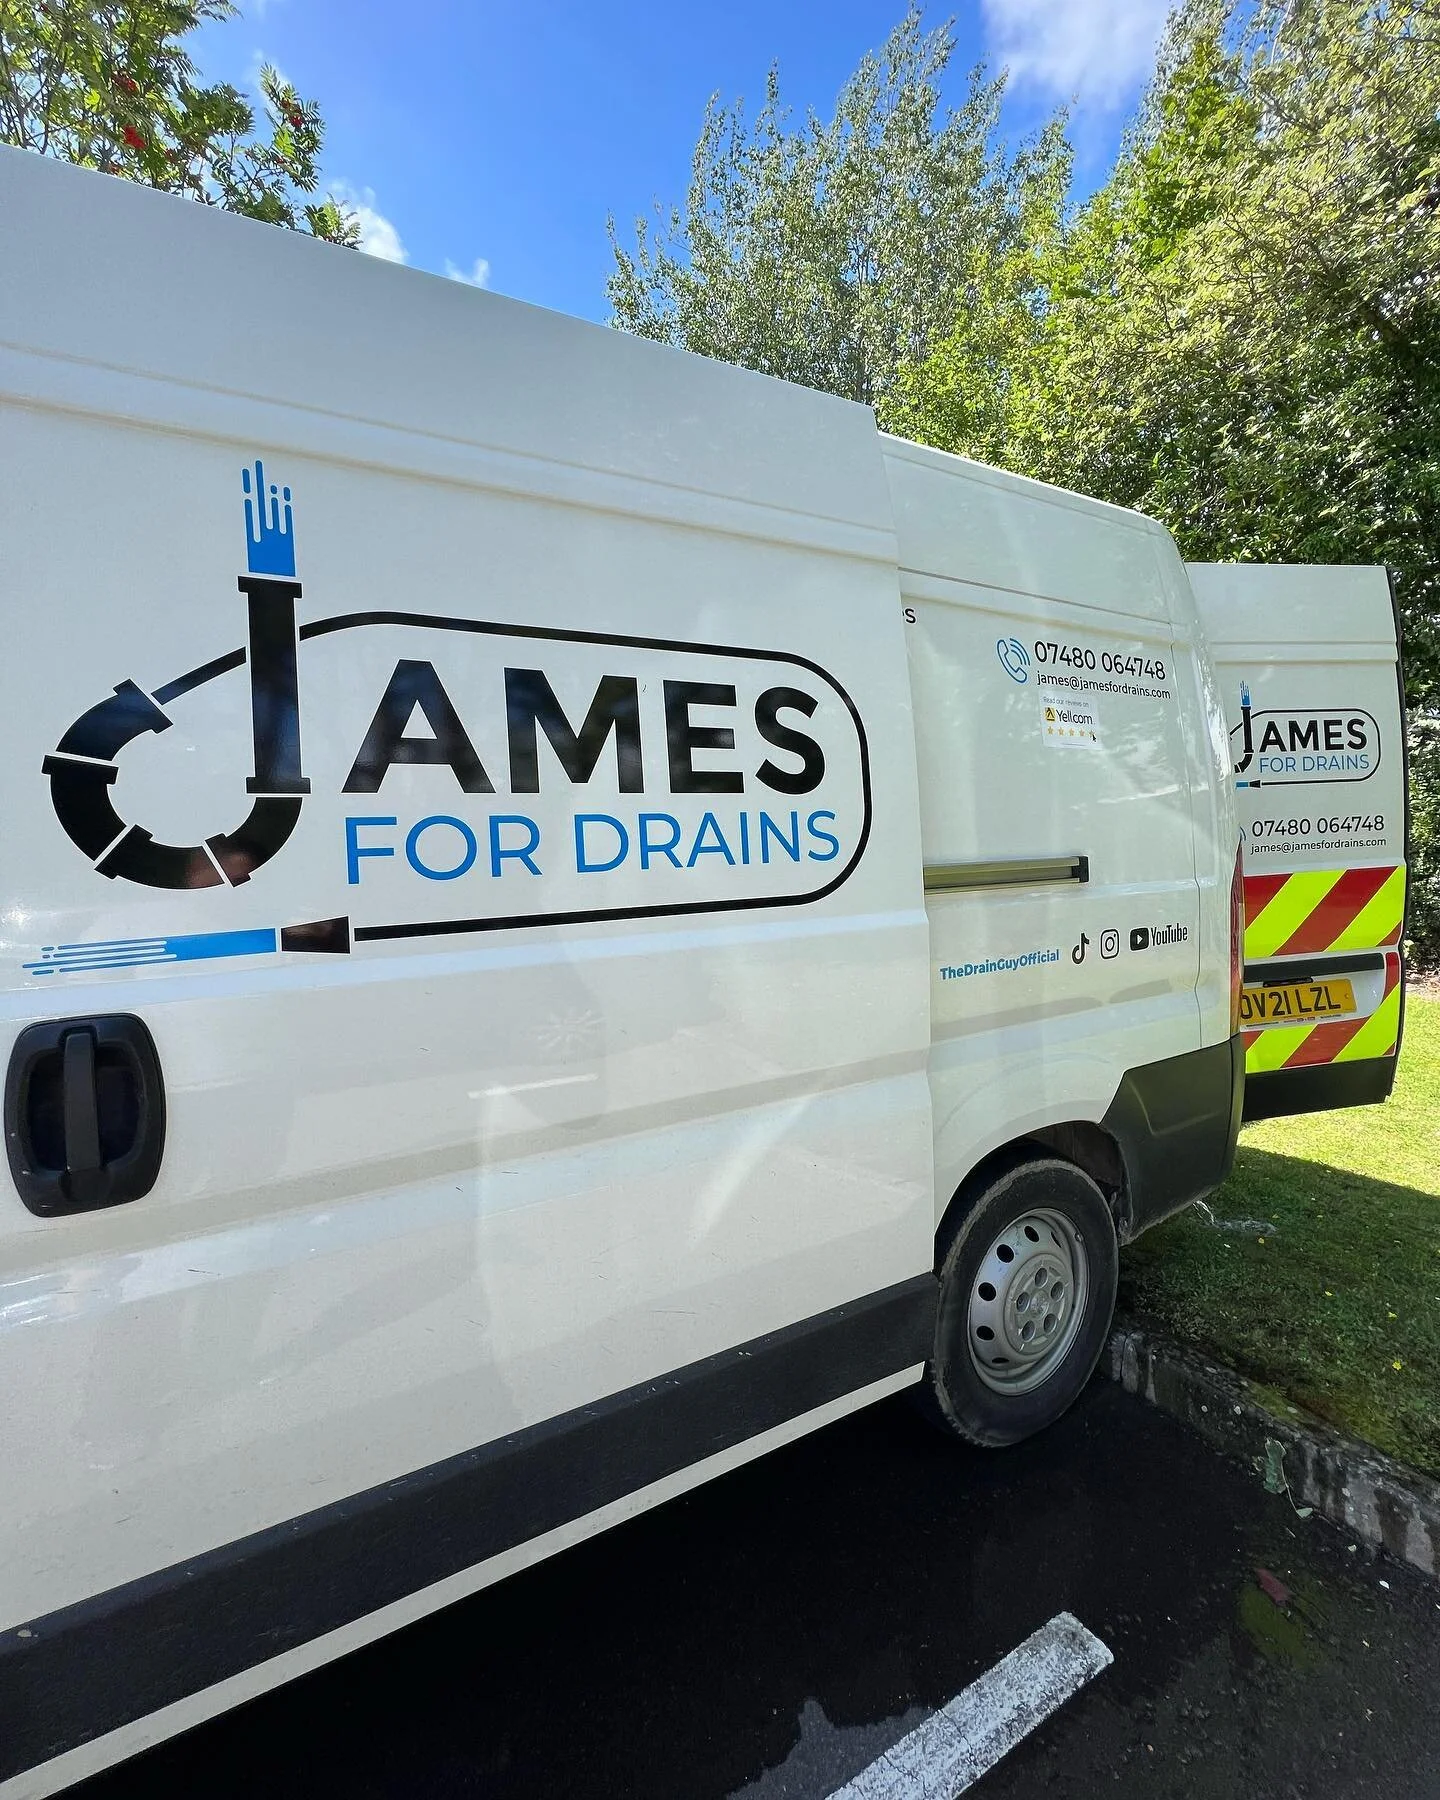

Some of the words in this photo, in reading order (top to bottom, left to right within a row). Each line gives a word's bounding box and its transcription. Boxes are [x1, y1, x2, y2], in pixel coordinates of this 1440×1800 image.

[1034, 641, 1096, 670] 07480
[1101, 653, 1166, 680] 064748
[1036, 670, 1171, 700] james@jamesfordrains.com
[42, 575, 827, 889] JAMES
[1259, 756, 1297, 774] FOR
[1302, 754, 1370, 772] DRAINS
[1252, 819, 1311, 837] 07480
[1317, 815, 1385, 833] 064748
[346, 814, 543, 885] FOR
[576, 810, 841, 873] DRAINS
[1250, 837, 1387, 856] james@jamesfordrains.com
[1150, 922, 1188, 947] YouTube
[940, 949, 1060, 980] TheDrainGuyOfficial
[1295, 986, 1341, 1013] LZL
